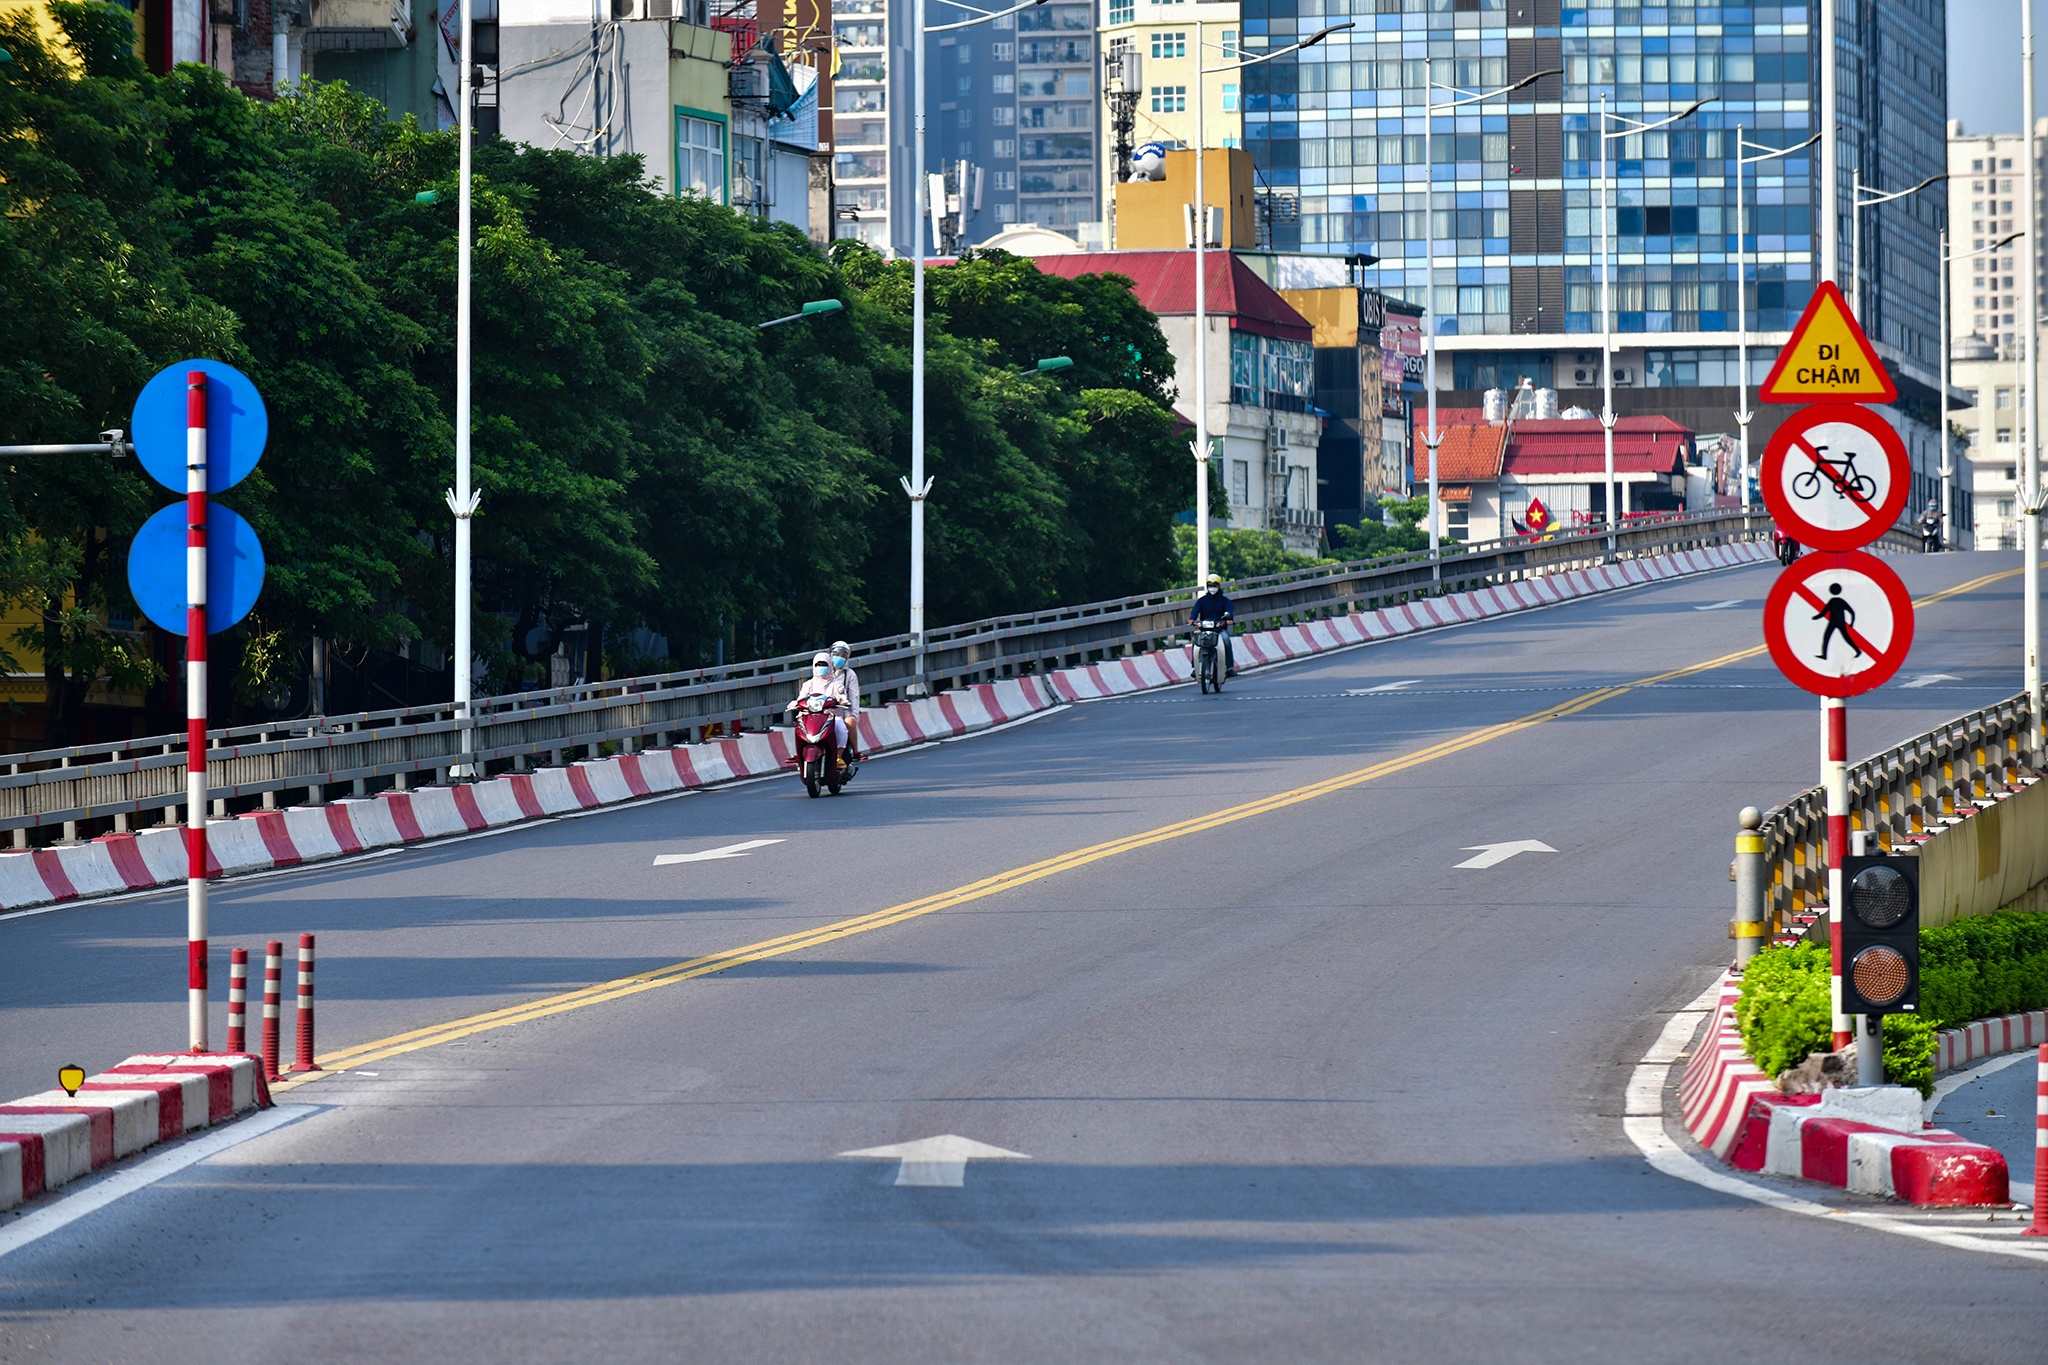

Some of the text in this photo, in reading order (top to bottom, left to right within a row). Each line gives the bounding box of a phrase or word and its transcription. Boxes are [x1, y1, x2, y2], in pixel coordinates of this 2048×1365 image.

[1363, 292, 1380, 326] OBIS
[1818, 344, 1839, 360] ĐI
[1797, 364, 1859, 387] CHẬM
